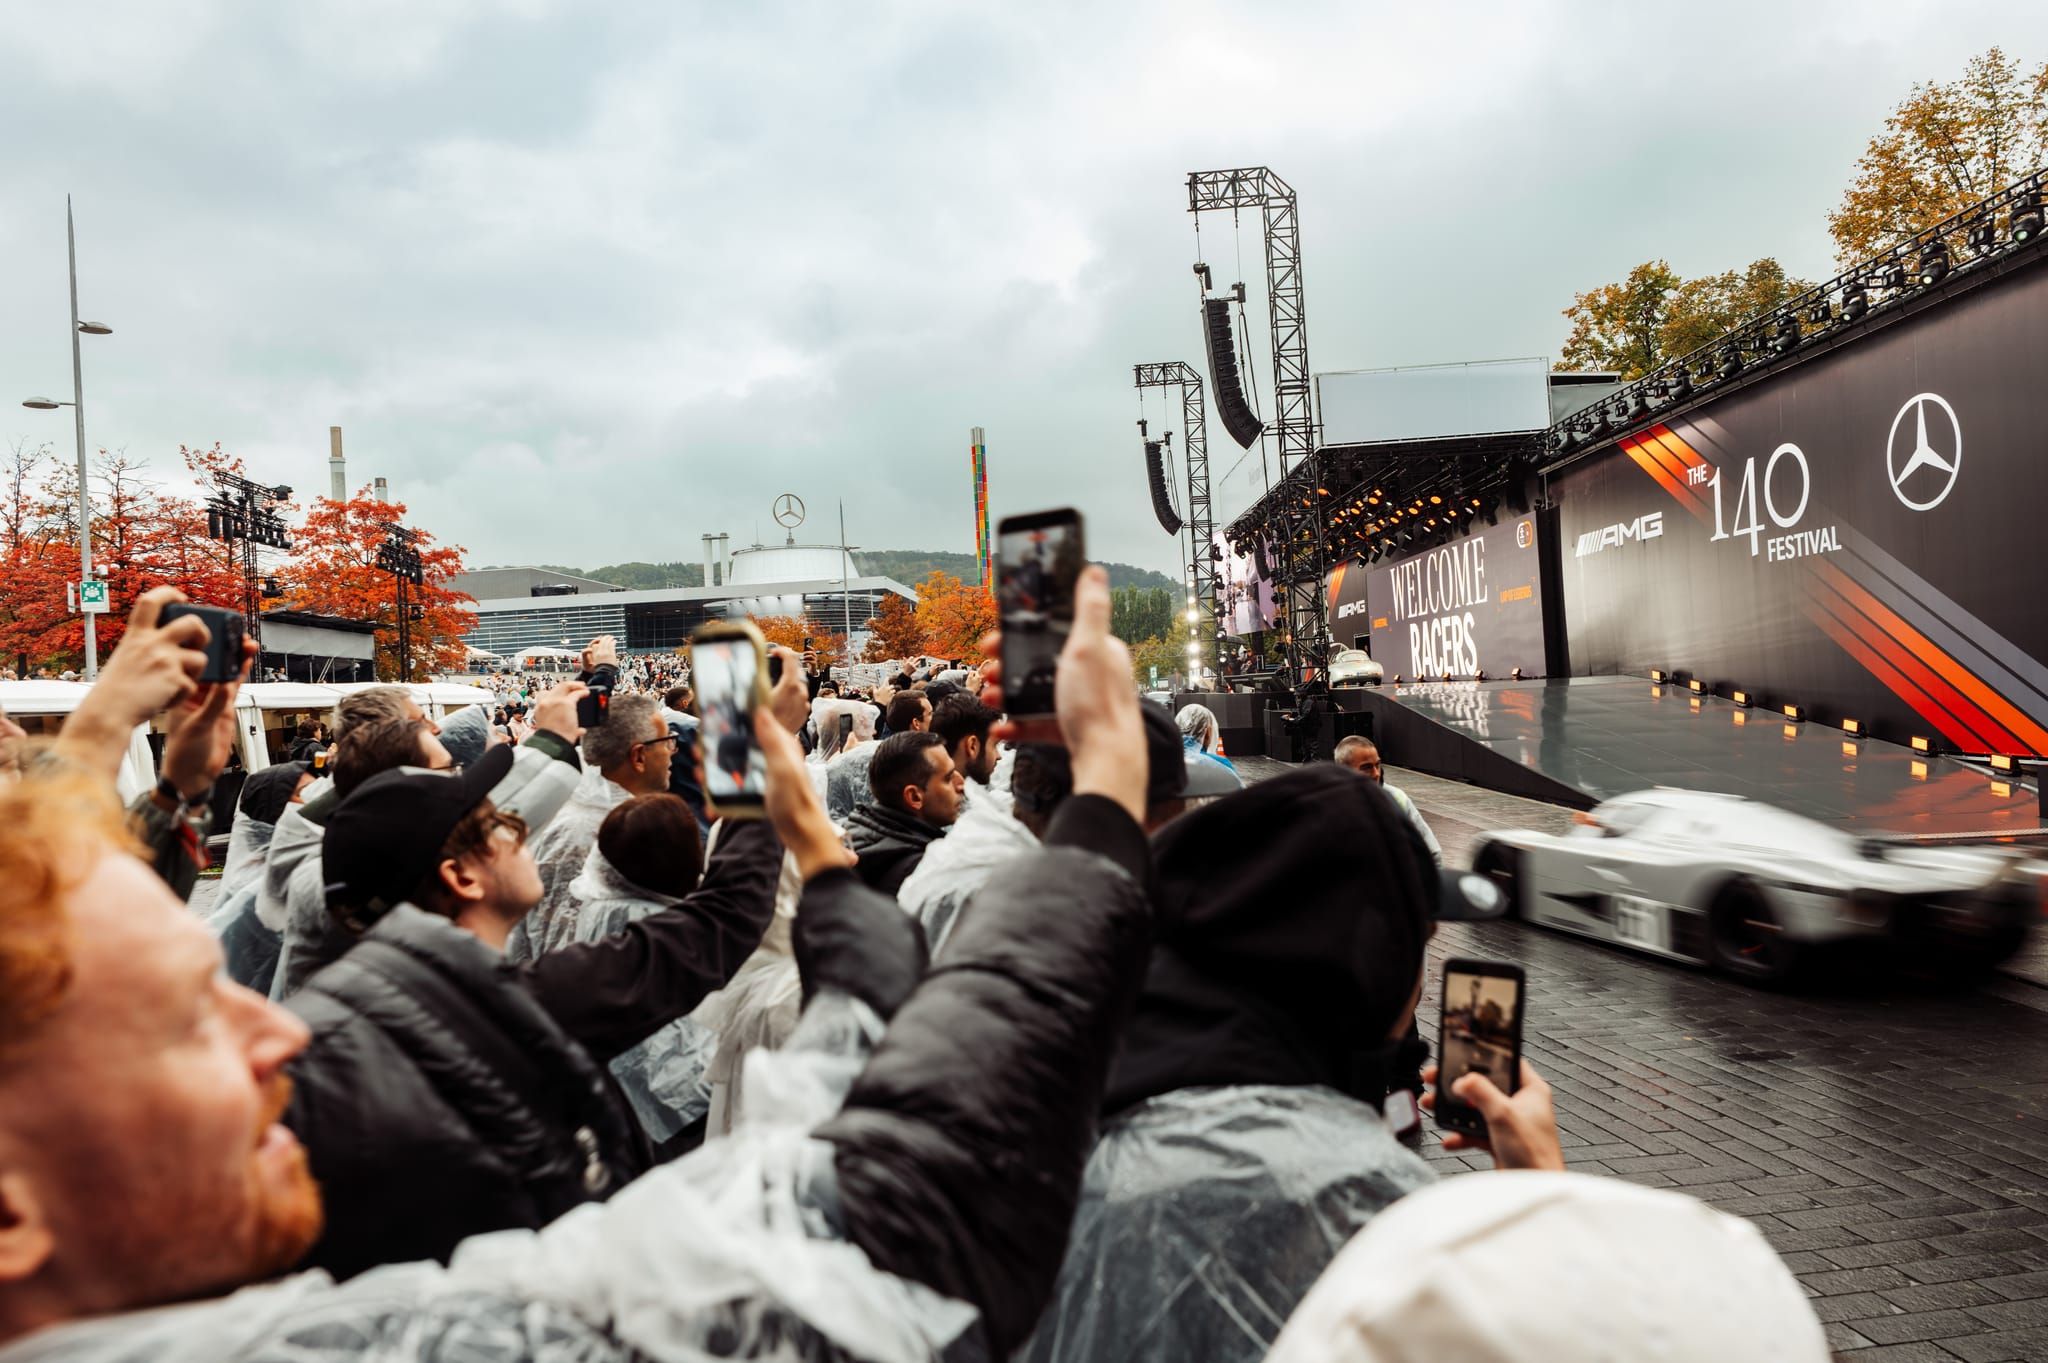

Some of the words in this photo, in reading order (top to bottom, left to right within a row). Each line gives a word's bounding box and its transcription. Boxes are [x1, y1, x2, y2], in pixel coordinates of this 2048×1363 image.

[1598, 512, 1664, 552] AMG
[1686, 464, 1707, 486] THE
[1707, 443, 1810, 557] 140
[1767, 526, 1842, 562] FESTIVAL
[1390, 536, 1488, 622] WELCOME
[1409, 612, 1478, 678] RACERS
